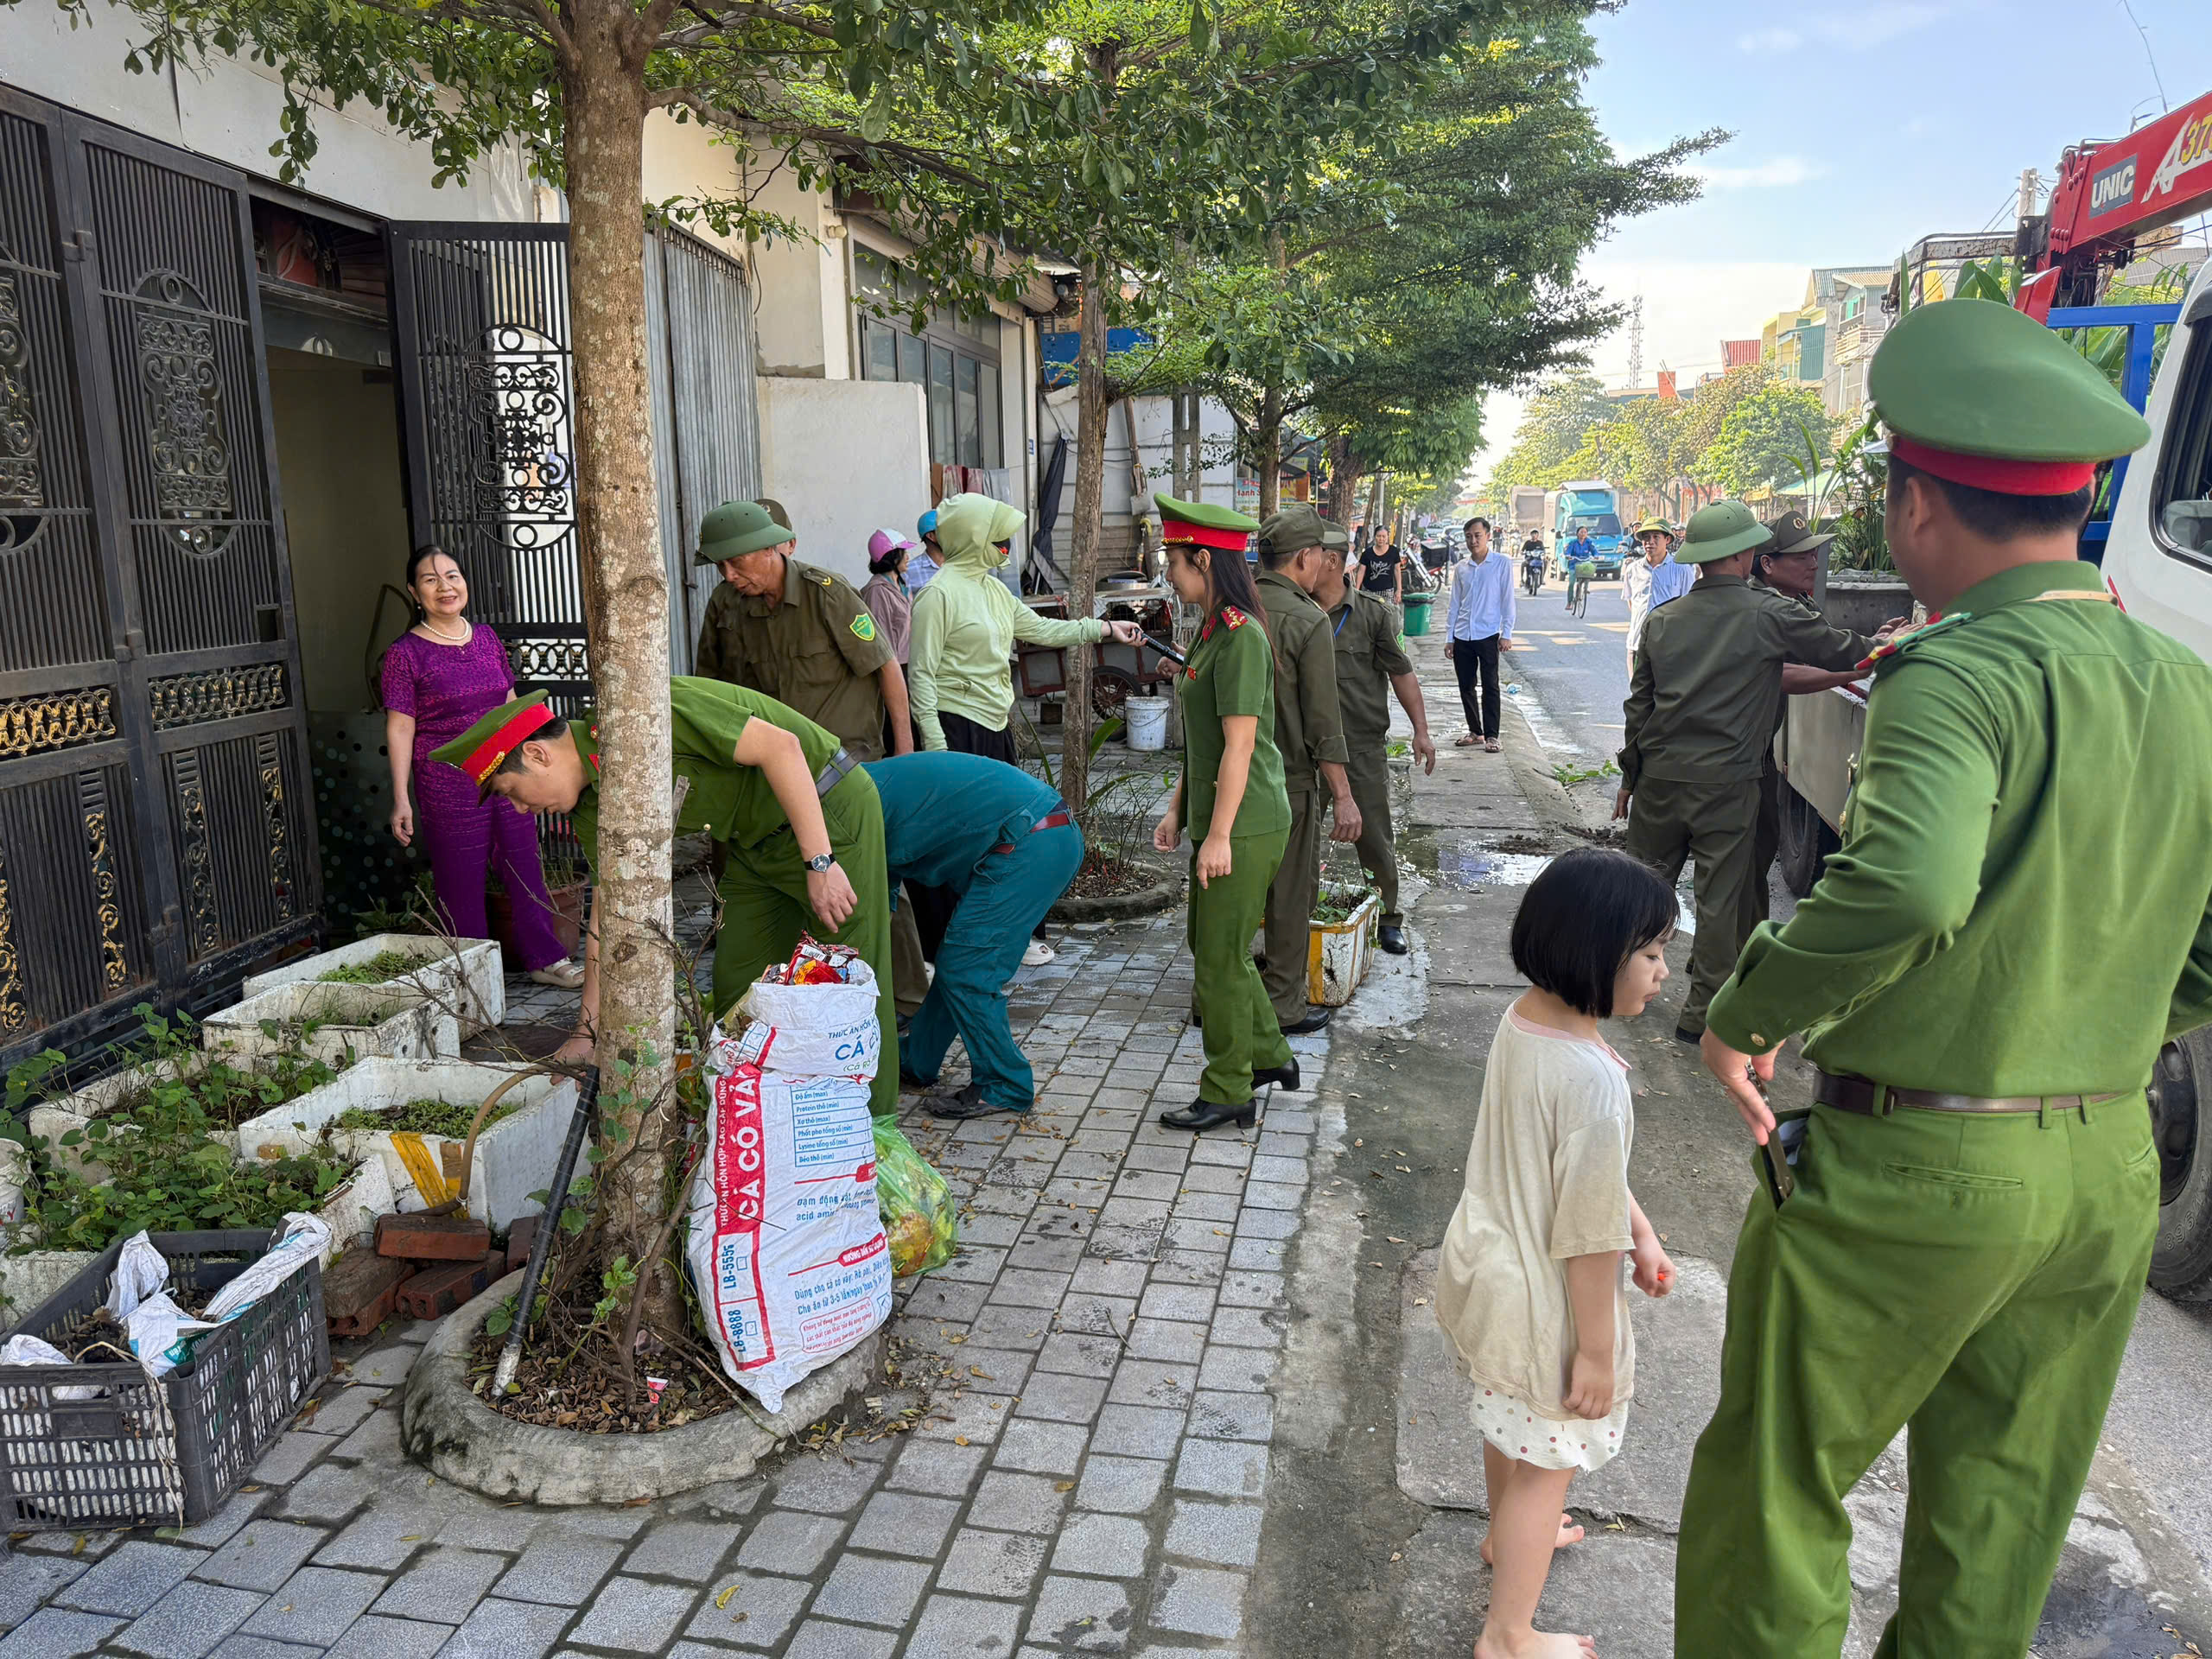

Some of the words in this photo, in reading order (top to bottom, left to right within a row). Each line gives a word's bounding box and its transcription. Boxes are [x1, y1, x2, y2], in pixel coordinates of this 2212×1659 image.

[2091, 165, 2134, 208] UNIC
[835, 1034, 864, 1061] CÁ
[717, 1080, 728, 1106] DÙNG
[796, 1104, 817, 1113] Protein
[718, 1127, 727, 1146] CAO
[811, 1128, 822, 1136] pho
[729, 1126, 760, 1172] CÓ
[798, 1141, 816, 1150] Lysine
[836, 1137, 849, 1146] (min)
[717, 1147, 728, 1167] HỢP
[799, 1154, 810, 1163] Béo
[716, 1169, 728, 1189] HỖN
[733, 1178, 760, 1220] CÁ
[796, 1211, 814, 1221] acid
[795, 1287, 812, 1300] Dùng
[814, 1284, 825, 1294] cho
[798, 1304, 811, 1315] Cho
[830, 1294, 841, 1305] 3-5
[728, 1309, 747, 1353] LB-8888
